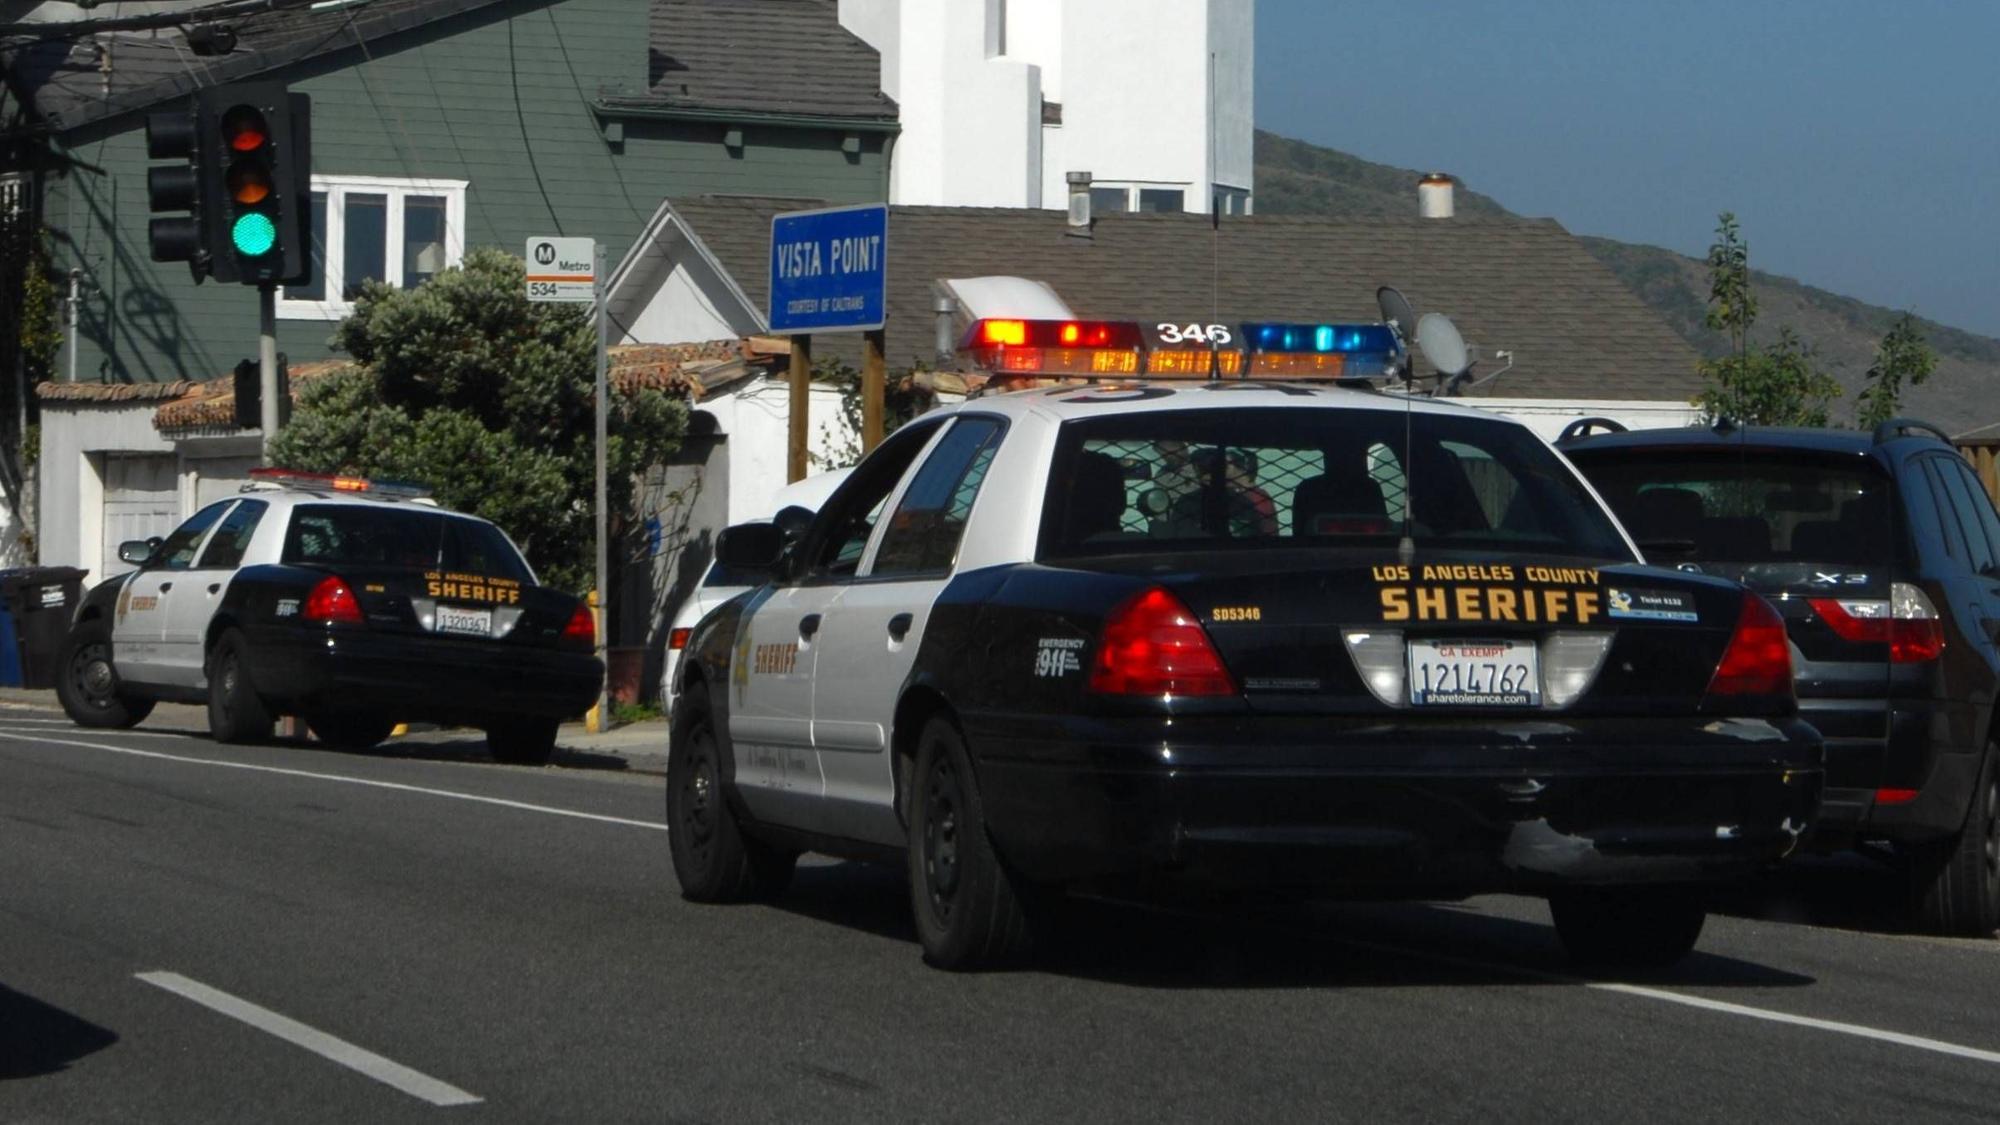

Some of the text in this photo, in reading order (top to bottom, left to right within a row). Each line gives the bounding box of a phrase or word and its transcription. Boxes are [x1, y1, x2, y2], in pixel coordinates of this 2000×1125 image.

[558, 260, 591, 271] Metro
[778, 235, 880, 278] VISTA POINT
[531, 282, 557, 296] 534
[1157, 323, 1231, 343] 346
[424, 571, 520, 589] LOS ANGELES COUNTY
[1373, 565, 1600, 585] LOS ANGELES COUNTY
[428, 581, 520, 604] SHERIFF
[1212, 607, 1261, 621] SD5346
[1381, 588, 1600, 624] SHERIFF
[755, 643, 798, 674] SHERIFF
[1440, 647, 1505, 657] CA EXEMPT
[1421, 663, 1529, 693] 1214762
[1427, 693, 1527, 704] sharetolerance.com
